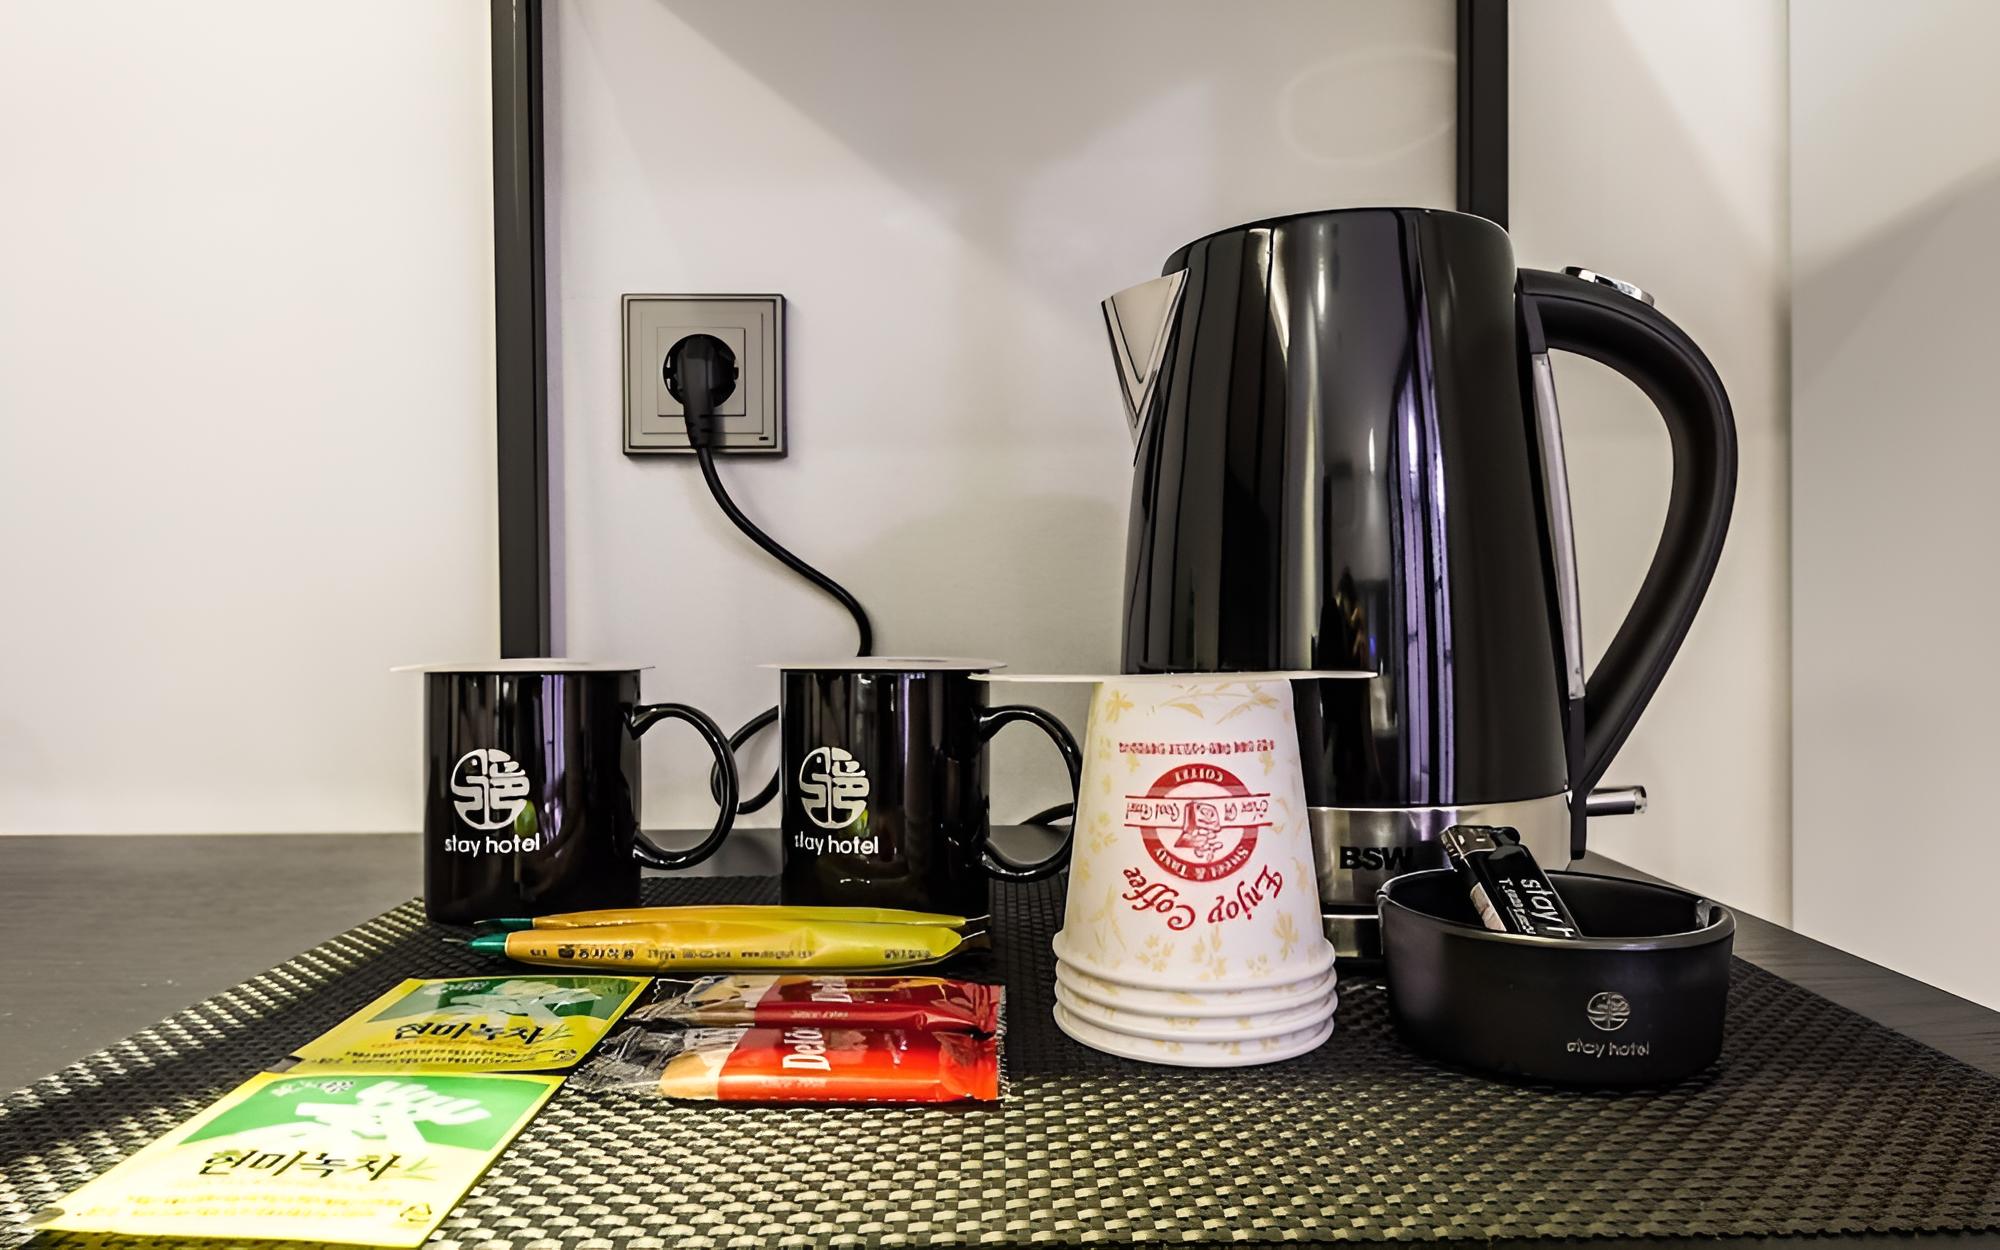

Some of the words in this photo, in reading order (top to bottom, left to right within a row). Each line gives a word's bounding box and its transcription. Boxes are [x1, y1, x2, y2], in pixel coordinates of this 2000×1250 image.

[444, 834, 481, 858] stay
[485, 832, 540, 853] hotel
[794, 831, 824, 856] stay
[828, 834, 879, 854] hotel
[1339, 846, 1413, 870] BSW
[1122, 867, 1196, 931] Coffee
[1207, 864, 1283, 924] Enjoy
[1520, 877, 1564, 925] stay
[1608, 1041, 1650, 1056] hotel
[199, 1148, 402, 1182] 현미녹차
